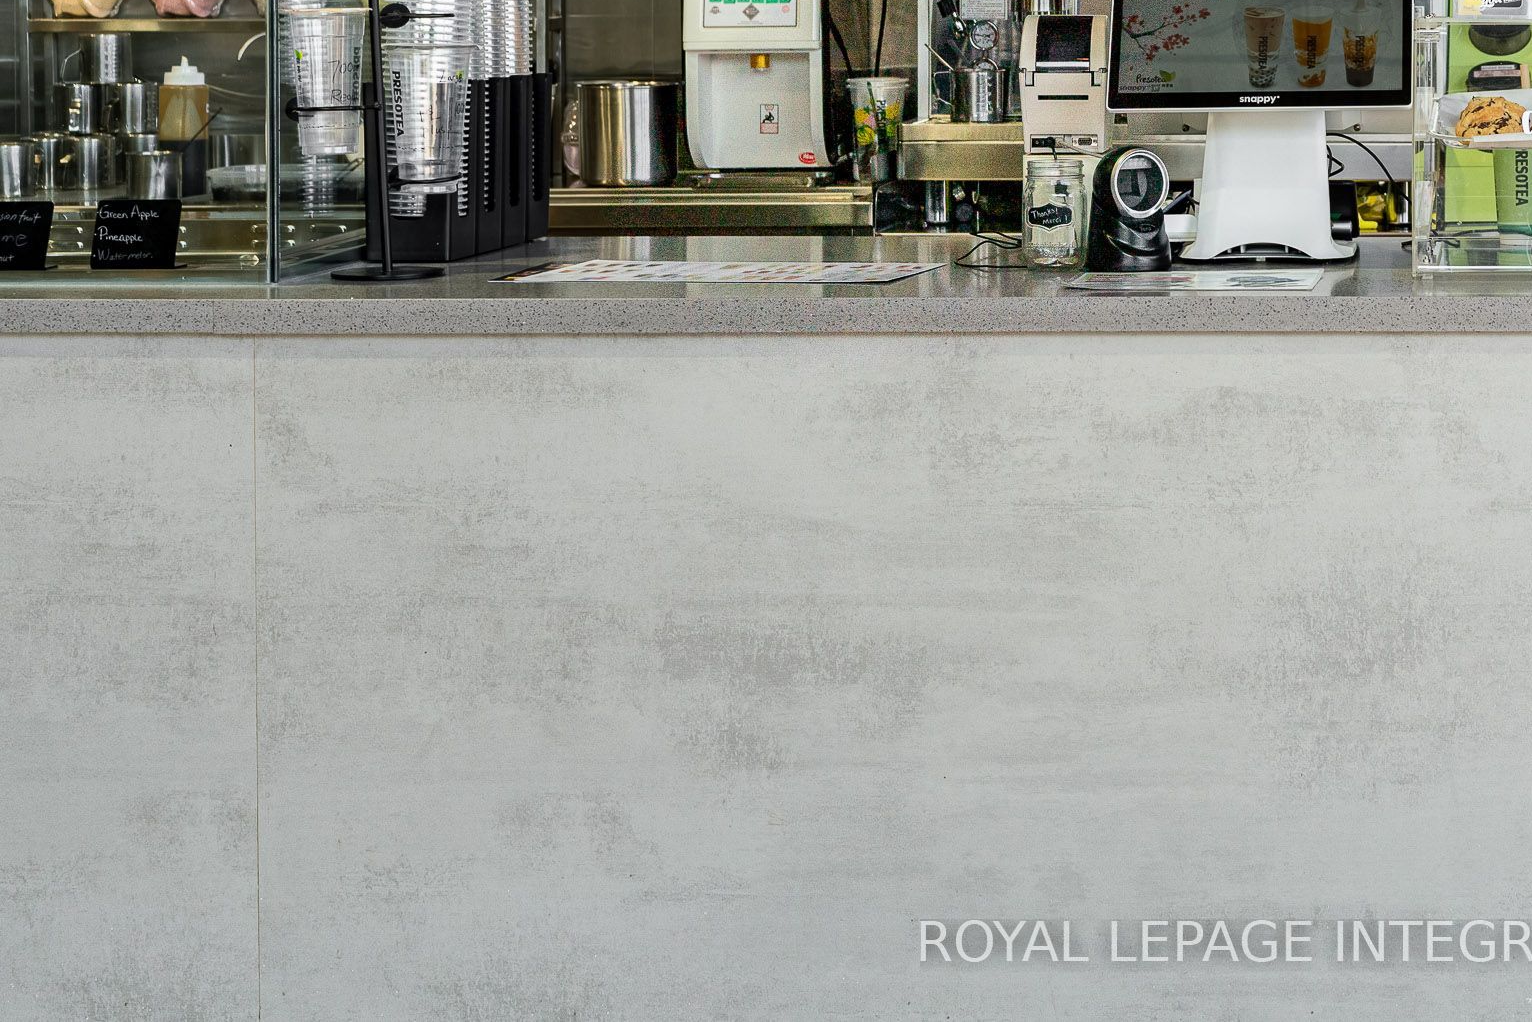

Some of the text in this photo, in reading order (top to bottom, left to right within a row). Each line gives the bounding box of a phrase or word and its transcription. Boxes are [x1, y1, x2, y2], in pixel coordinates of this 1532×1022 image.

[392, 70, 405, 137] PRESOTEA
[1239, 94, 1278, 105] snappy
[1514, 150, 1529, 206] RESOTEA
[100, 205, 160, 220] Green Apple
[100, 226, 143, 244] Pineapple
